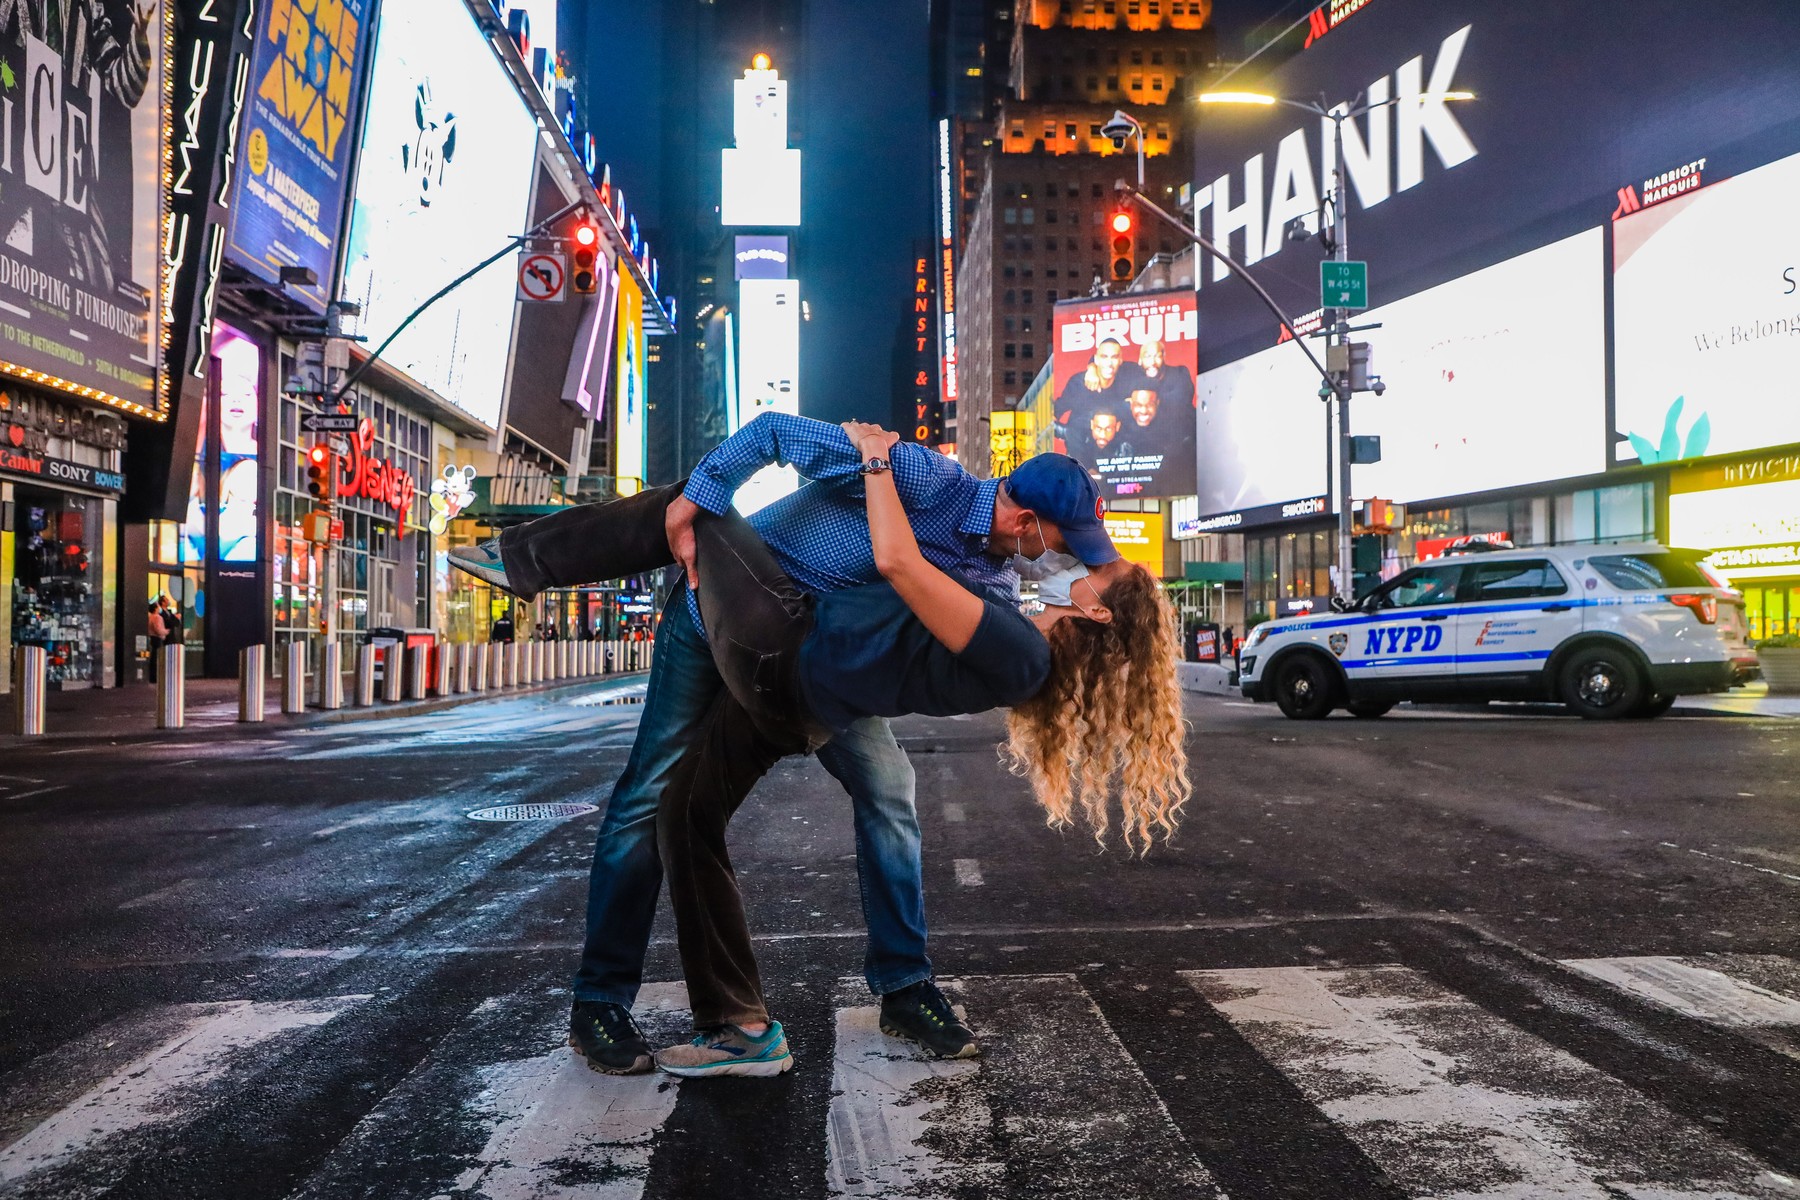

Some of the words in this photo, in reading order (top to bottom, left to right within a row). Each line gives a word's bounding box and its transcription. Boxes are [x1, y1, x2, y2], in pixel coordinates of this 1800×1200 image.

[257, 51, 346, 162] AWAY
[1194, 23, 1479, 292] THANK
[1643, 157, 1707, 192] MARRIOTT
[1643, 175, 1700, 205] MARQUIS
[0, 253, 71, 312] DROPPING
[1327, 280, 1336, 288] W
[1336, 280, 1350, 289] 45
[1351, 280, 1361, 289] St
[1338, 267, 1350, 276] TO
[914, 258, 929, 352] ERNST
[1079, 311, 1119, 323] TYLER
[1124, 304, 1181, 318] PERRY'S
[1061, 310, 1198, 353] BRUH
[308, 418, 326, 427] ONE
[334, 418, 351, 427] WAY
[49, 461, 91, 483] SONY
[1282, 498, 1317, 517] swatch
[1282, 623, 1311, 633] POLICE
[1364, 625, 1442, 655] NYPD
